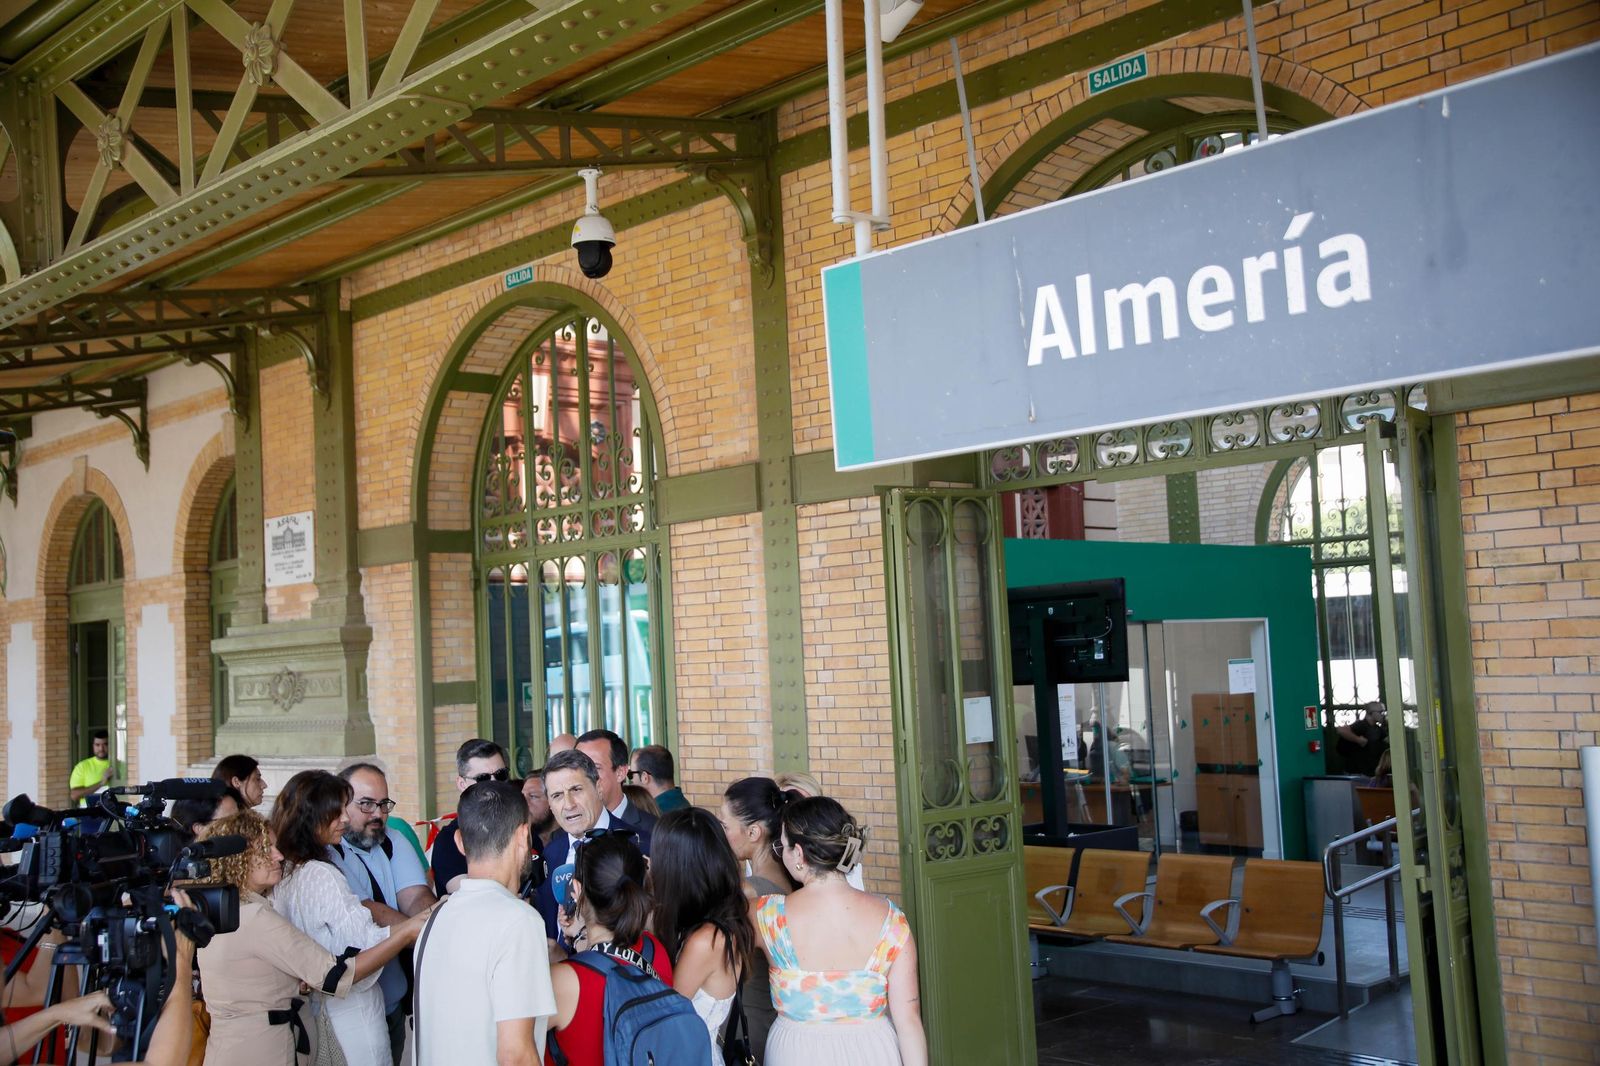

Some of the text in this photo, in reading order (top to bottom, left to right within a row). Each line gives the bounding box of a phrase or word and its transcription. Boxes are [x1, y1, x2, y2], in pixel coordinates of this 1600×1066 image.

[1093, 59, 1142, 88] SALIDA
[507, 268, 532, 286] SALIDA
[1027, 211, 1372, 367] Almería
[603, 942, 612, 953] Y
[614, 946, 644, 968] LOLA
